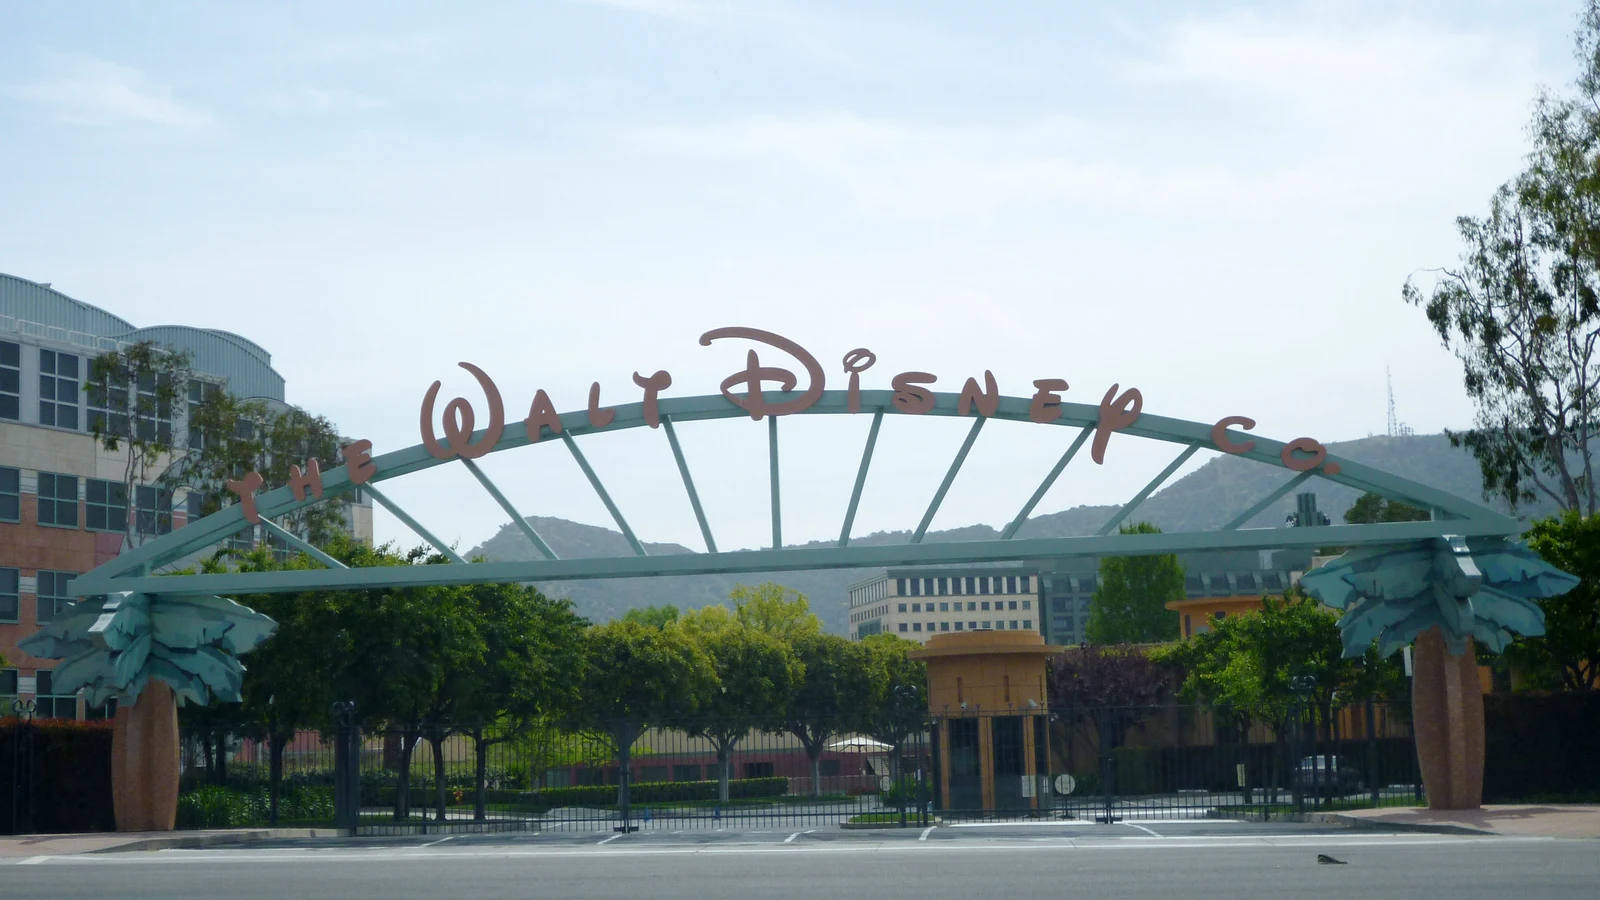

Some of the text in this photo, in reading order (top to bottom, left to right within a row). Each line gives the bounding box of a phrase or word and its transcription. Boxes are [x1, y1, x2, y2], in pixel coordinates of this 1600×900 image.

[229, 439, 377, 524] THE
[421, 362, 672, 459] WALT
[1211, 415, 1341, 475] CO.
